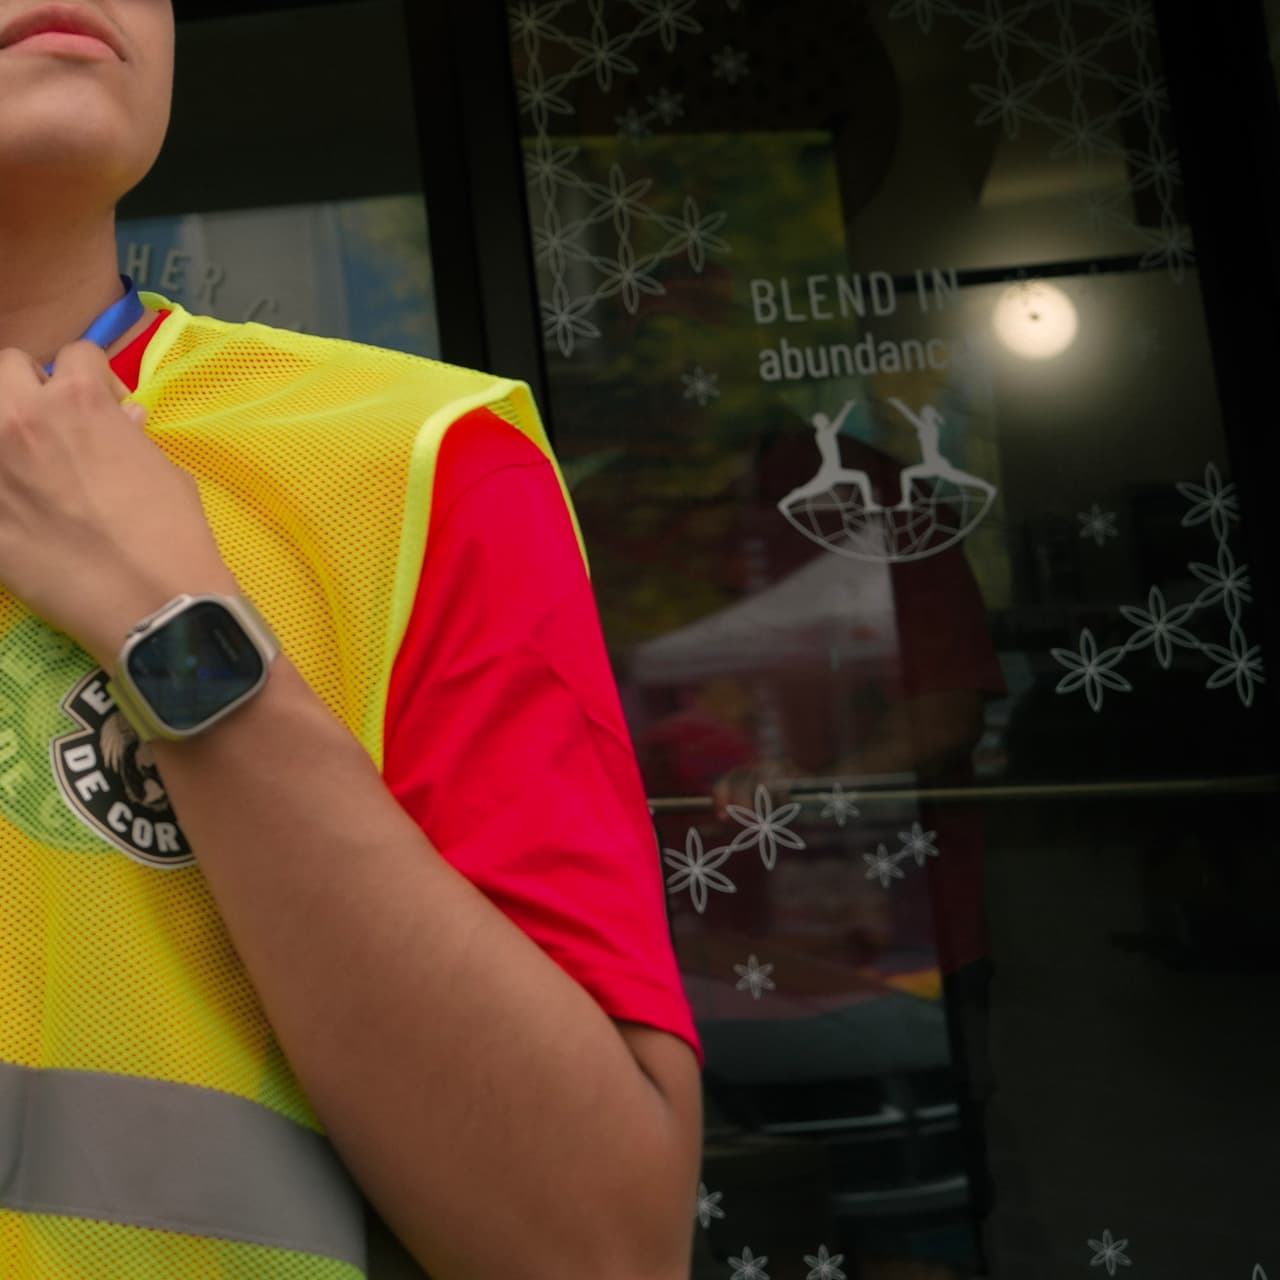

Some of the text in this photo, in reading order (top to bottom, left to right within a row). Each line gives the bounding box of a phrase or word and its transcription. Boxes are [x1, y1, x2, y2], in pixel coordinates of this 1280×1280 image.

[750, 267, 960, 325] BLEND IN
[758, 332, 950, 382] abundanc
[63, 743, 110, 801] DE
